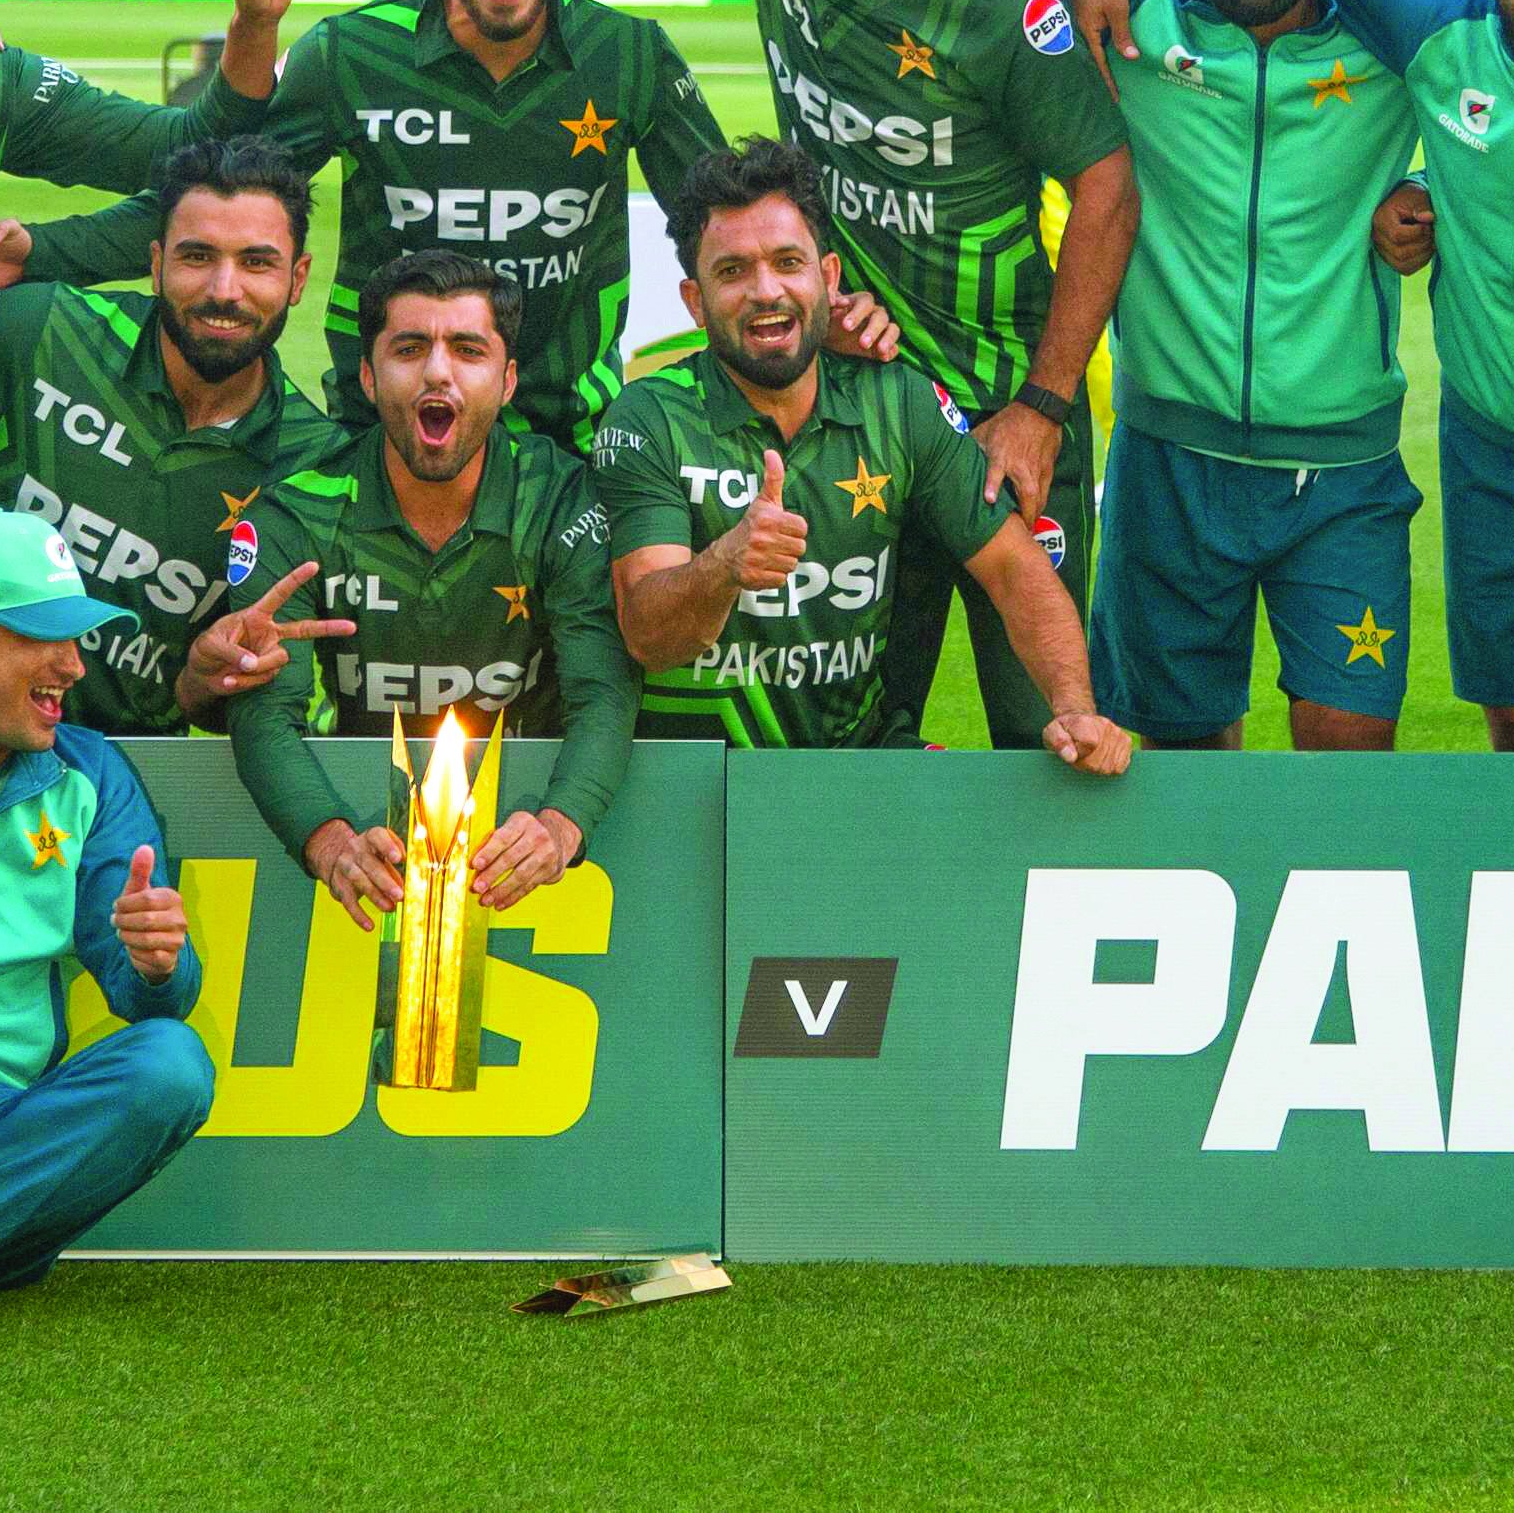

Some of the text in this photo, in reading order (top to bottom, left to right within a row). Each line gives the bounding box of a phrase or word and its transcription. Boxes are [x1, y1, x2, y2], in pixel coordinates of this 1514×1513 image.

[1028, 7, 1069, 44] PEPSI
[356, 108, 471, 146] TCL
[1438, 113, 1490, 154] GATORADE
[384, 183, 608, 243] PEPSI
[33, 378, 133, 467] TCL
[15, 473, 229, 624] PEPSI
[738, 544, 890, 617] EPSI
[693, 632, 875, 690] PAKISTAN
[61, 858, 615, 1137] US
